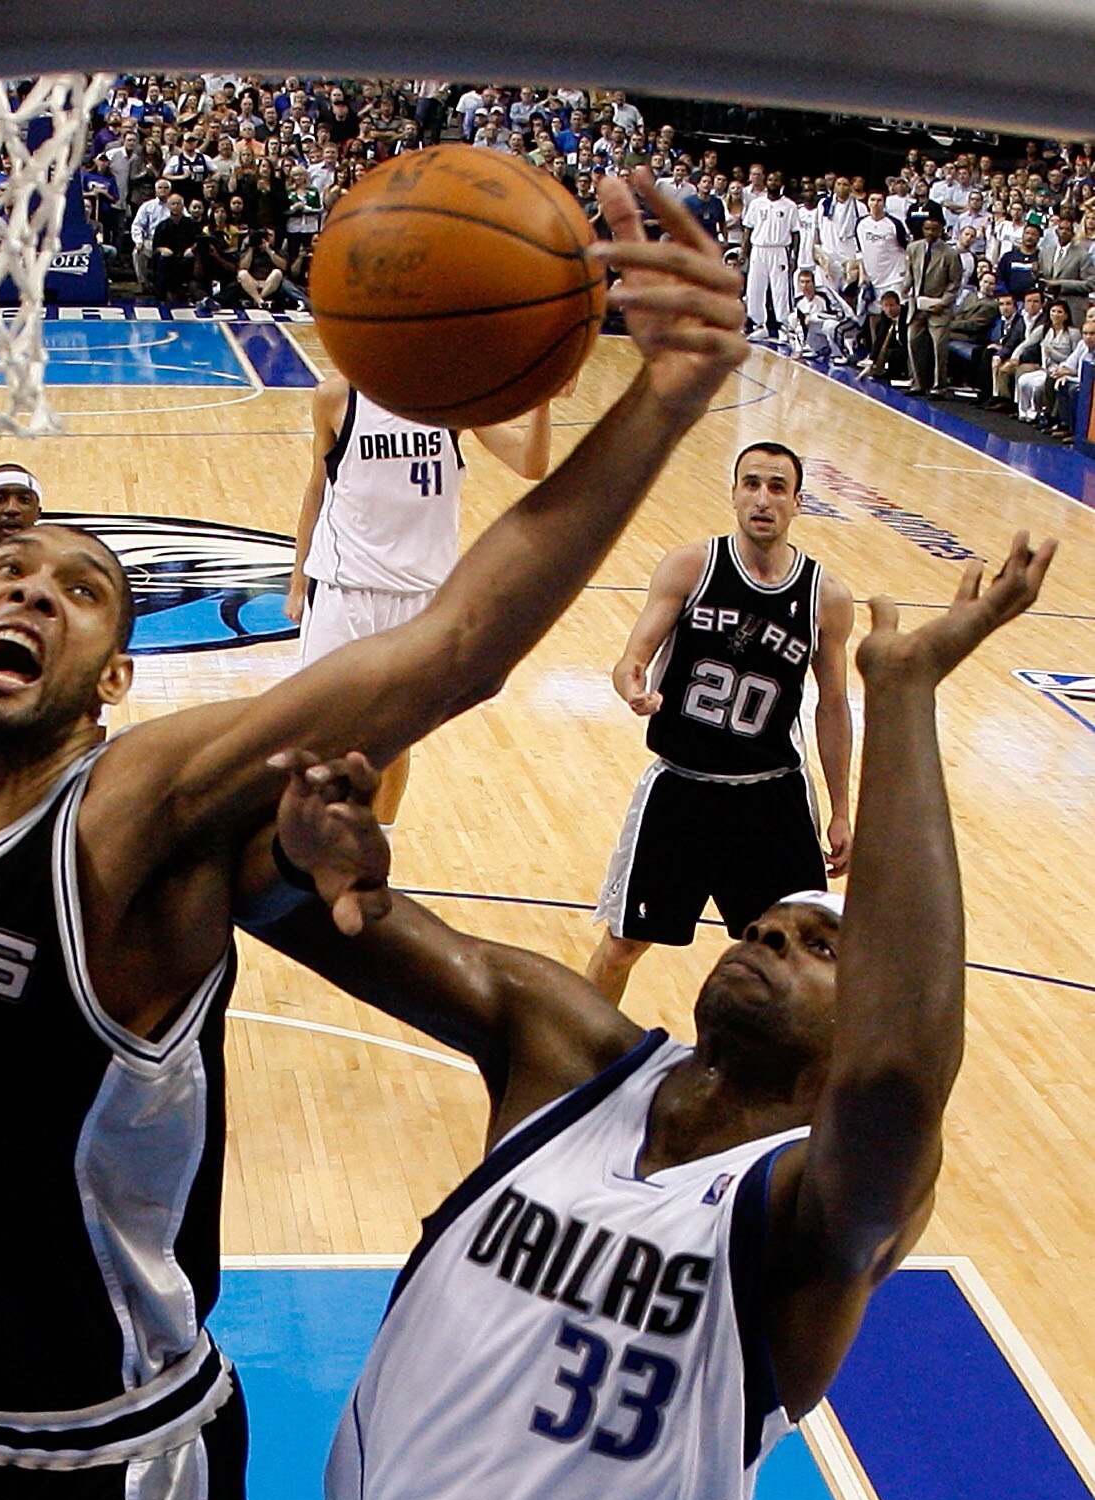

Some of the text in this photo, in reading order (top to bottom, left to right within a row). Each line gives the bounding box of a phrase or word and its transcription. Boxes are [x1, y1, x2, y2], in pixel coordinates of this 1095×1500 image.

[360, 431, 442, 460] DALLAS
[410, 460, 443, 497] 41
[681, 657, 781, 738] 20
[465, 1184, 714, 1341] DALLAS
[529, 1317, 682, 1462] 33
